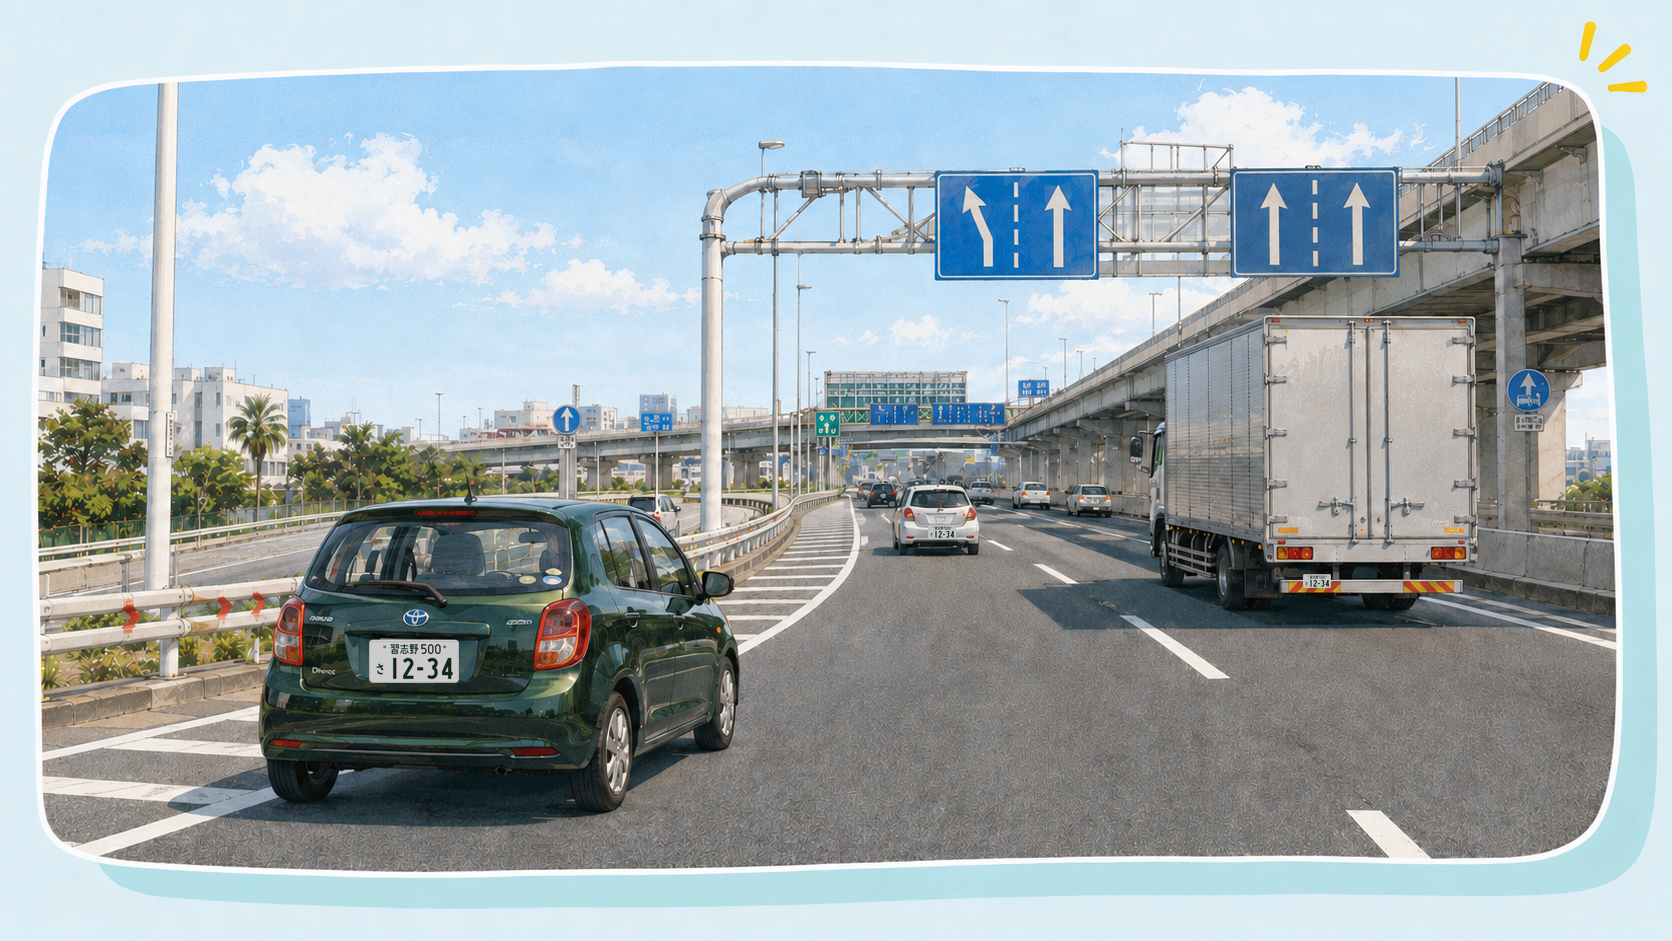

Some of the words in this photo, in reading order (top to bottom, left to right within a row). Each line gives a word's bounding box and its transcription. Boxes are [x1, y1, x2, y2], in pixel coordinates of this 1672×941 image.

[934, 530, 954, 538] 12-34
[1309, 579, 1329, 587] 12-34
[390, 643, 418, 655] 習志野
[420, 643, 442, 655] 500
[376, 663, 384, 675] さ
[392, 657, 454, 680] 12-34
